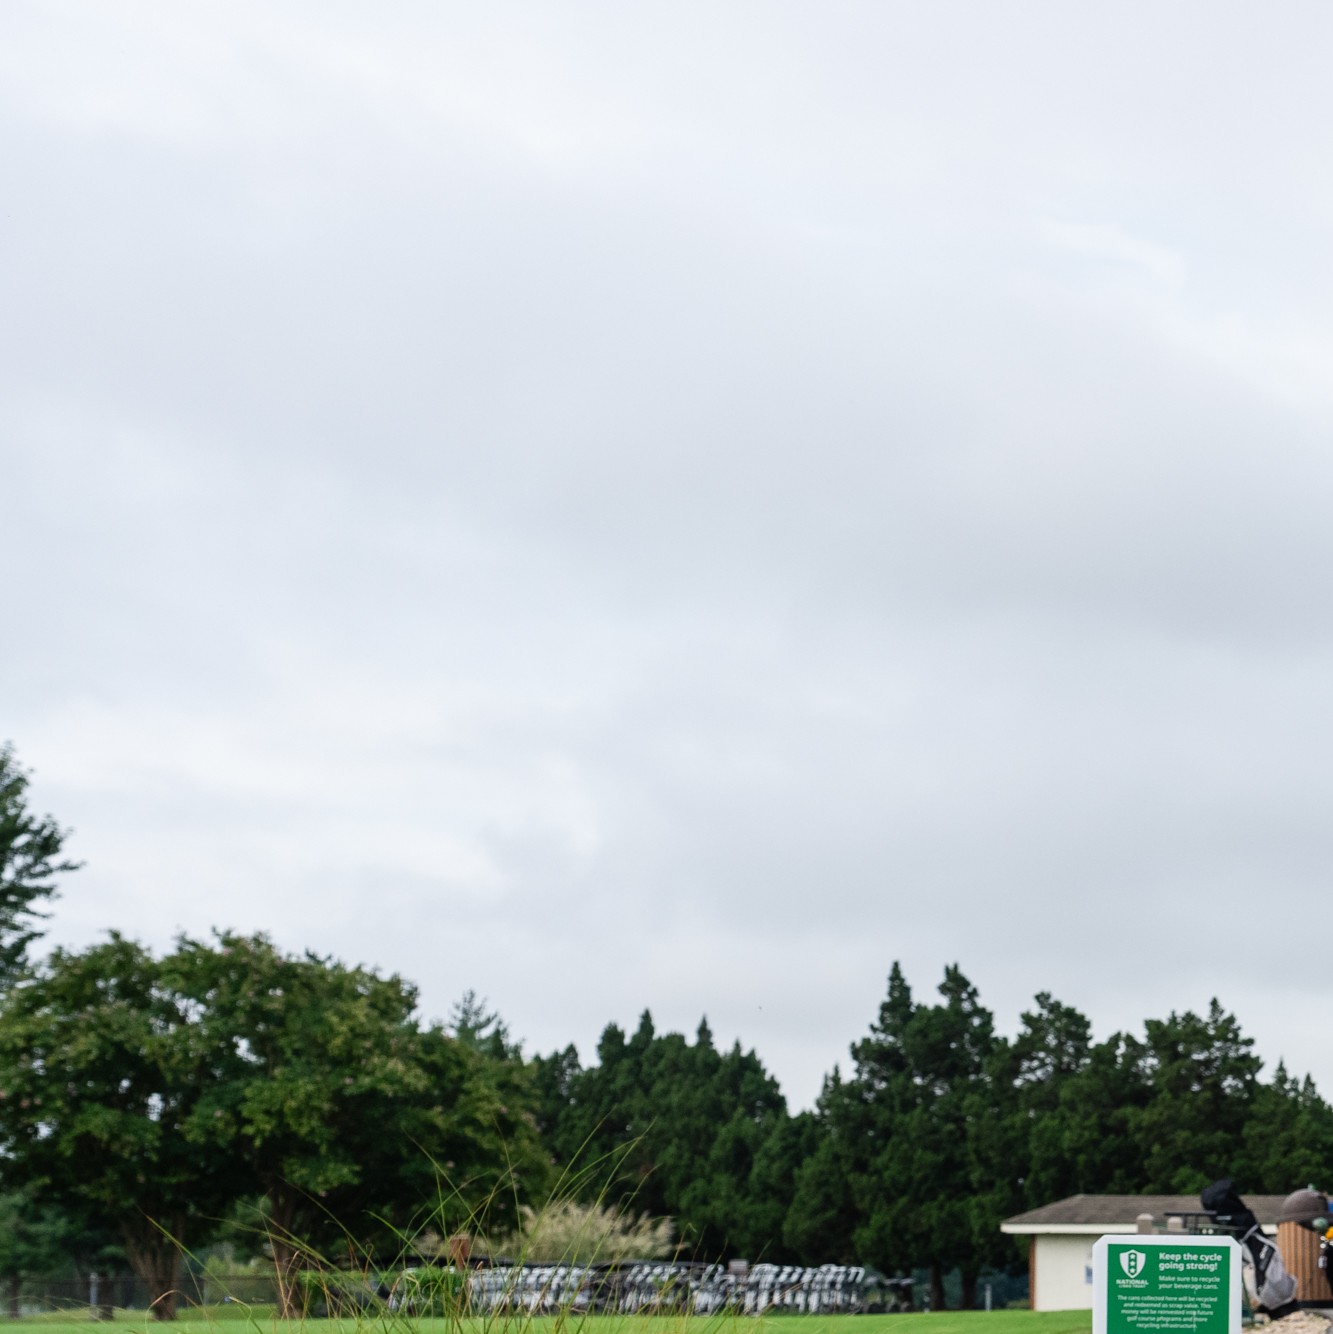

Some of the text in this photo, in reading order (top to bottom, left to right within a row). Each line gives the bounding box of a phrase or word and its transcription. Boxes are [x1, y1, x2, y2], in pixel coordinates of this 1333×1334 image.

[1159, 1252, 1222, 1262] Keep the cycle
[1159, 1262, 1218, 1272] going strong!
